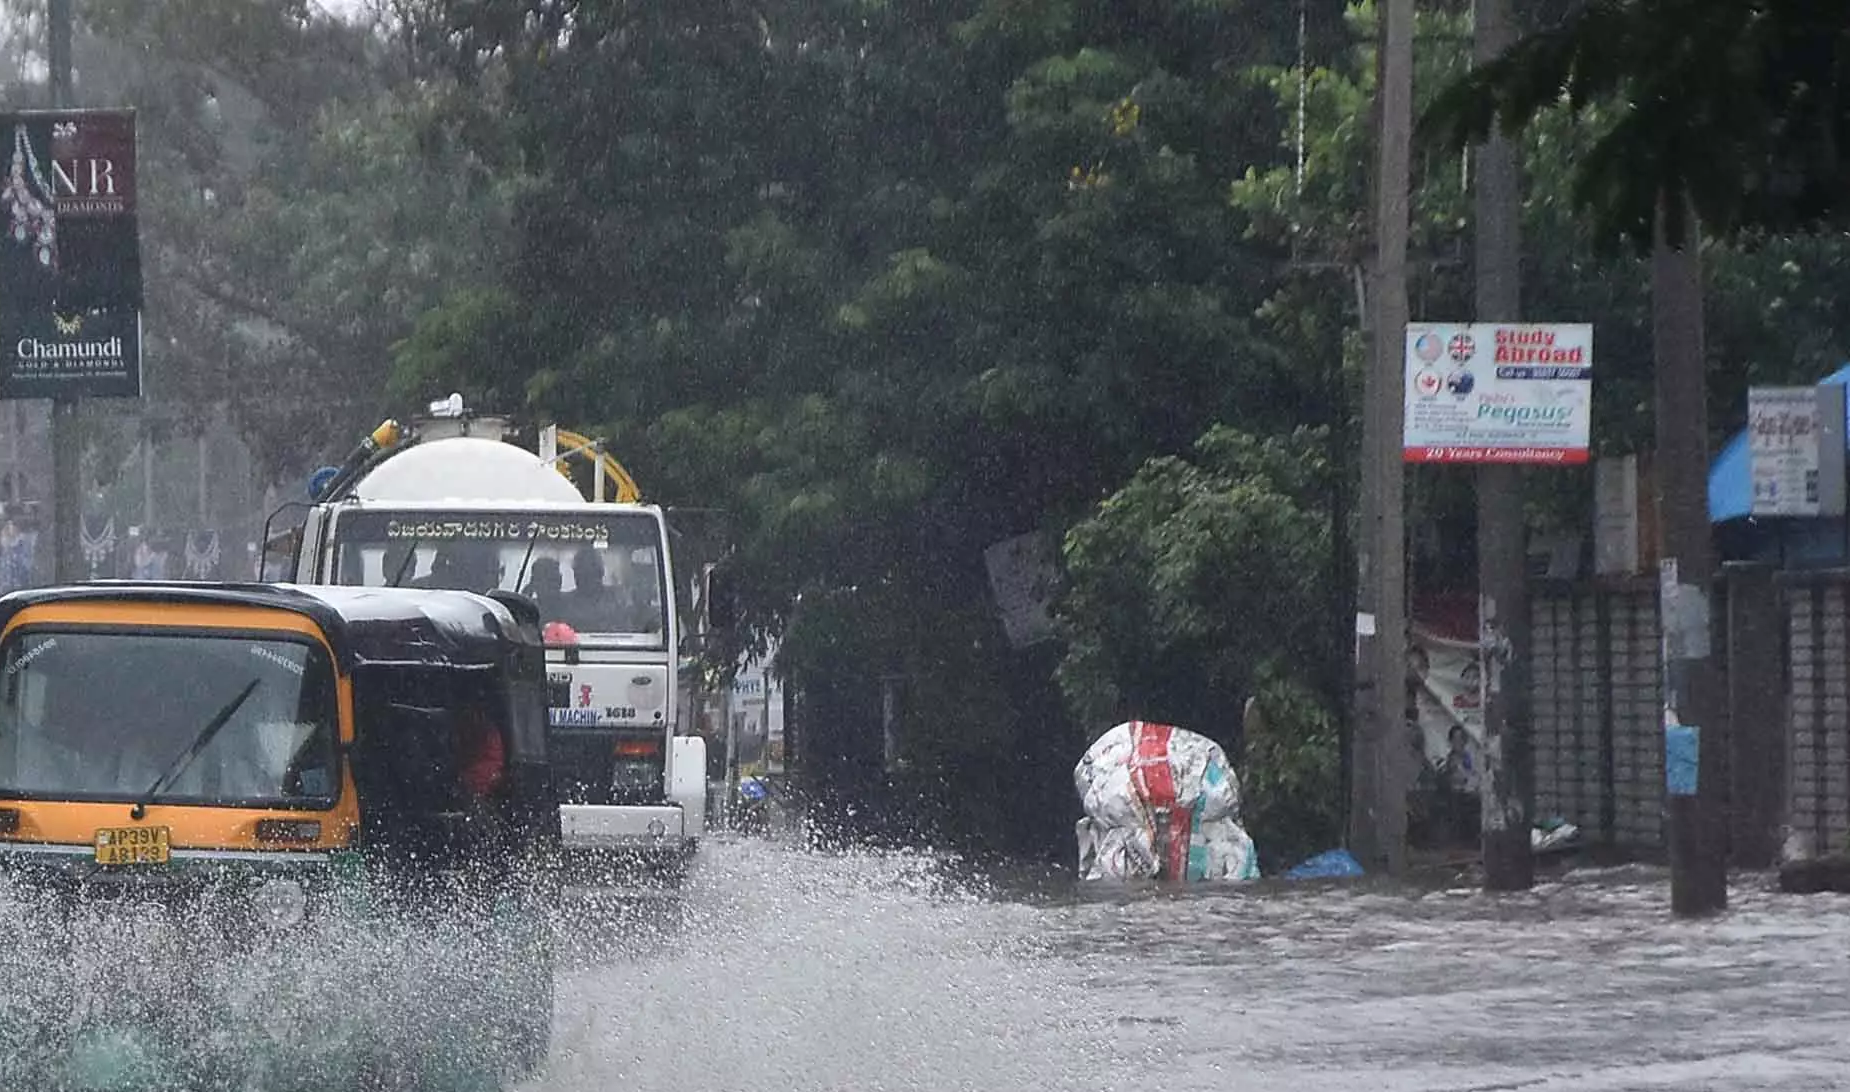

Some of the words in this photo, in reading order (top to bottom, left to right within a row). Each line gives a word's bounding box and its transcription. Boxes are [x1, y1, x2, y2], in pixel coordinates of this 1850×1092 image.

[57, 201, 125, 213] DIAMONDS
[1495, 328, 1555, 346] Study
[17, 336, 122, 359] Chamundi
[1495, 346, 1583, 363] Abroad
[109, 827, 159, 845] AP39V
